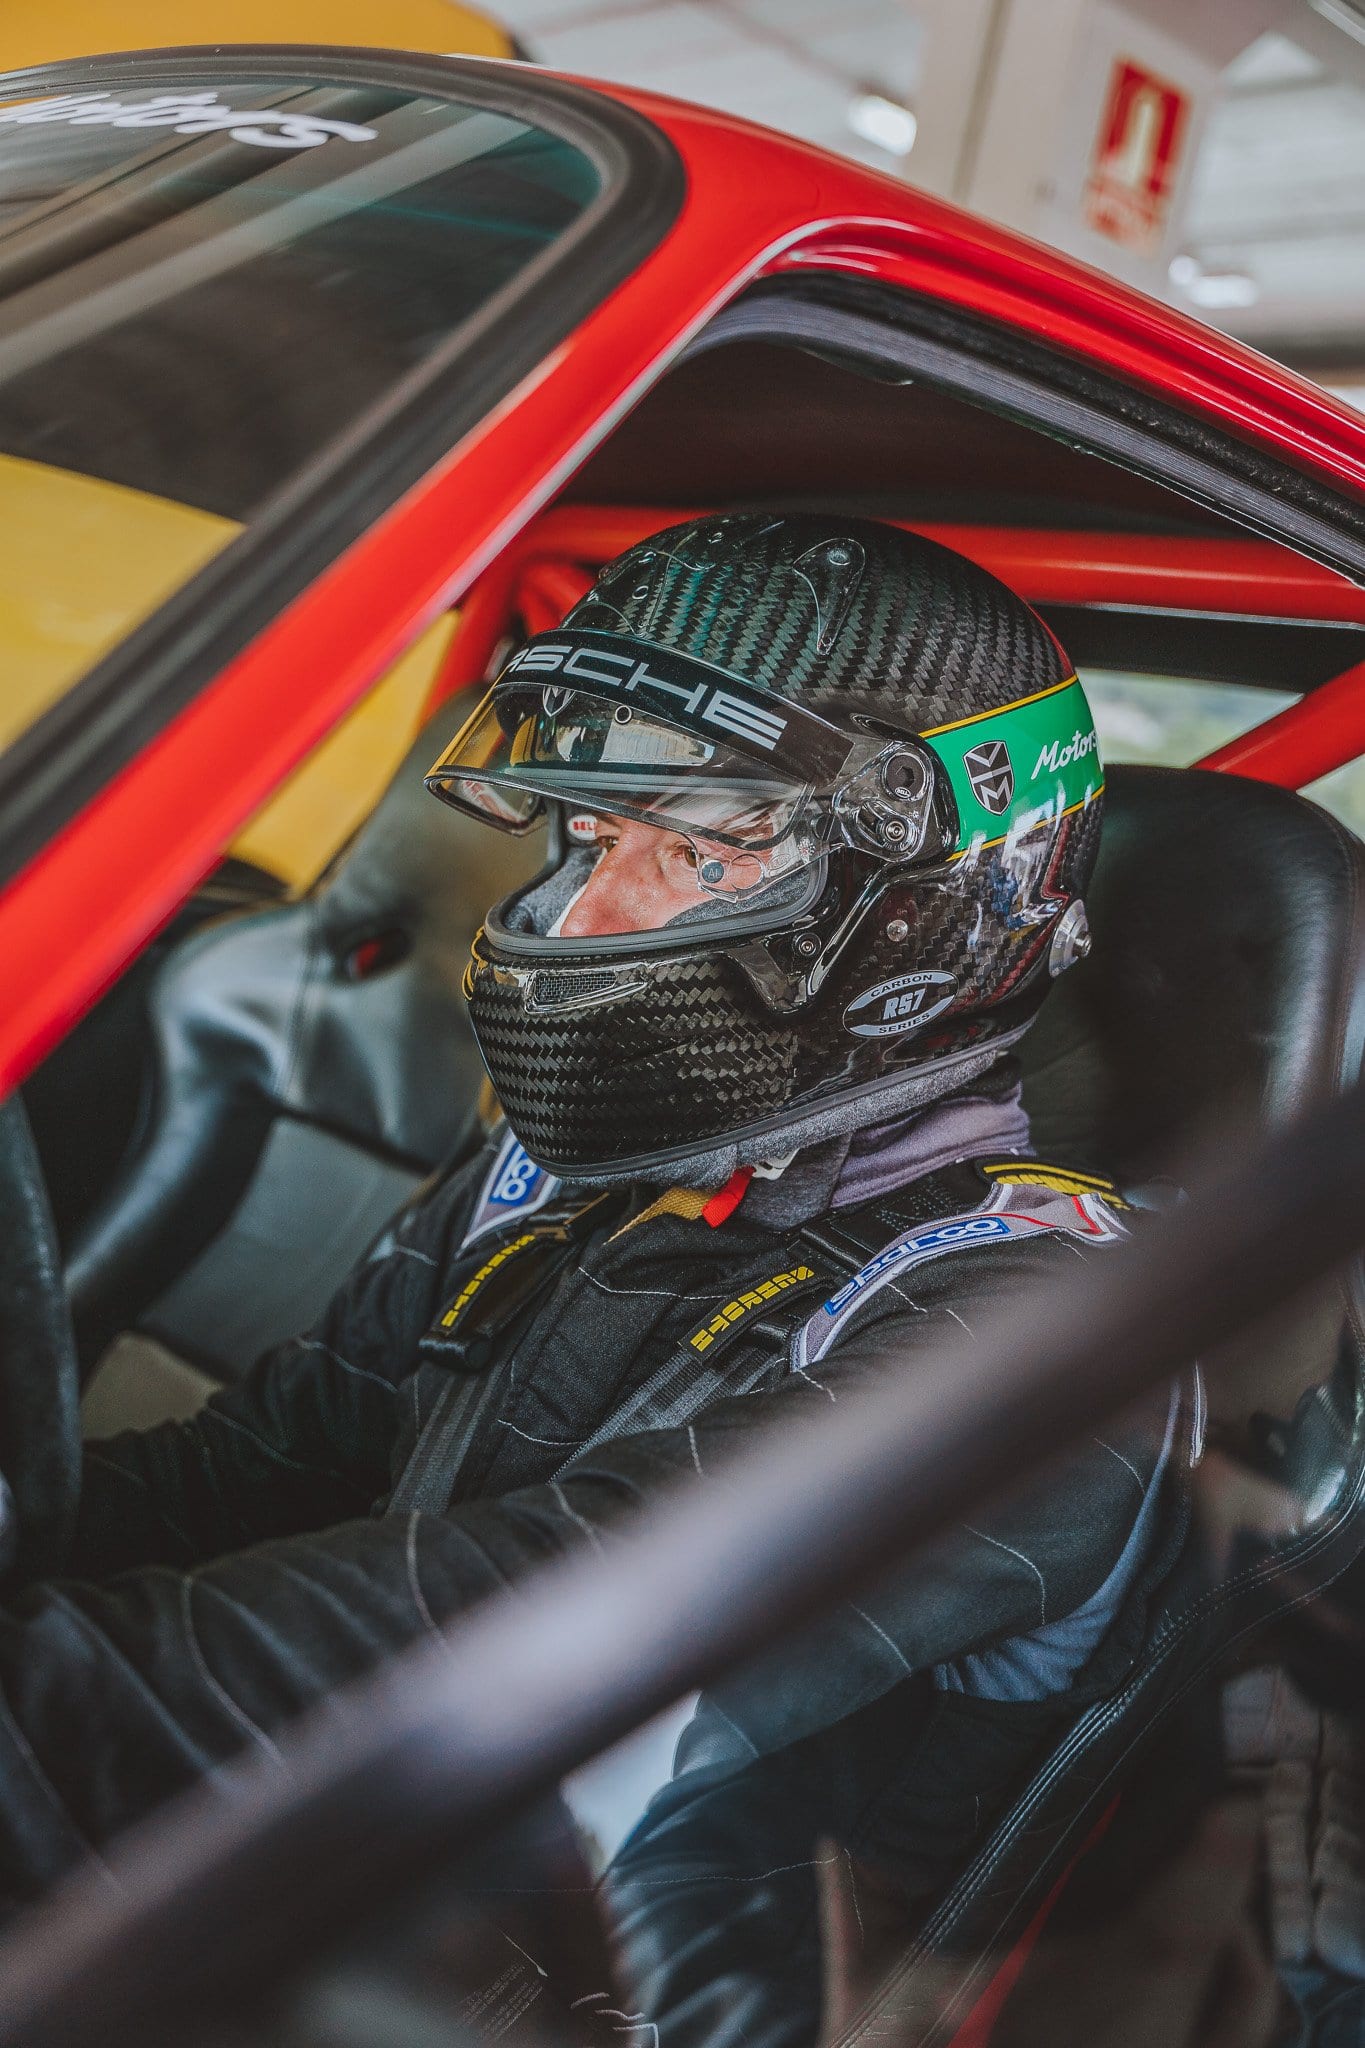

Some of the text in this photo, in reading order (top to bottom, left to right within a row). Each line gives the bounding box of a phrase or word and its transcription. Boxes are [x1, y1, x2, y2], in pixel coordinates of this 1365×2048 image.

[870, 974, 933, 998] CARBON
[882, 988, 926, 1021] RS7
[878, 1013, 931, 1034] SERIES
[830, 1217, 1003, 1312] sparco
[689, 1266, 815, 1352] SCHROTH
